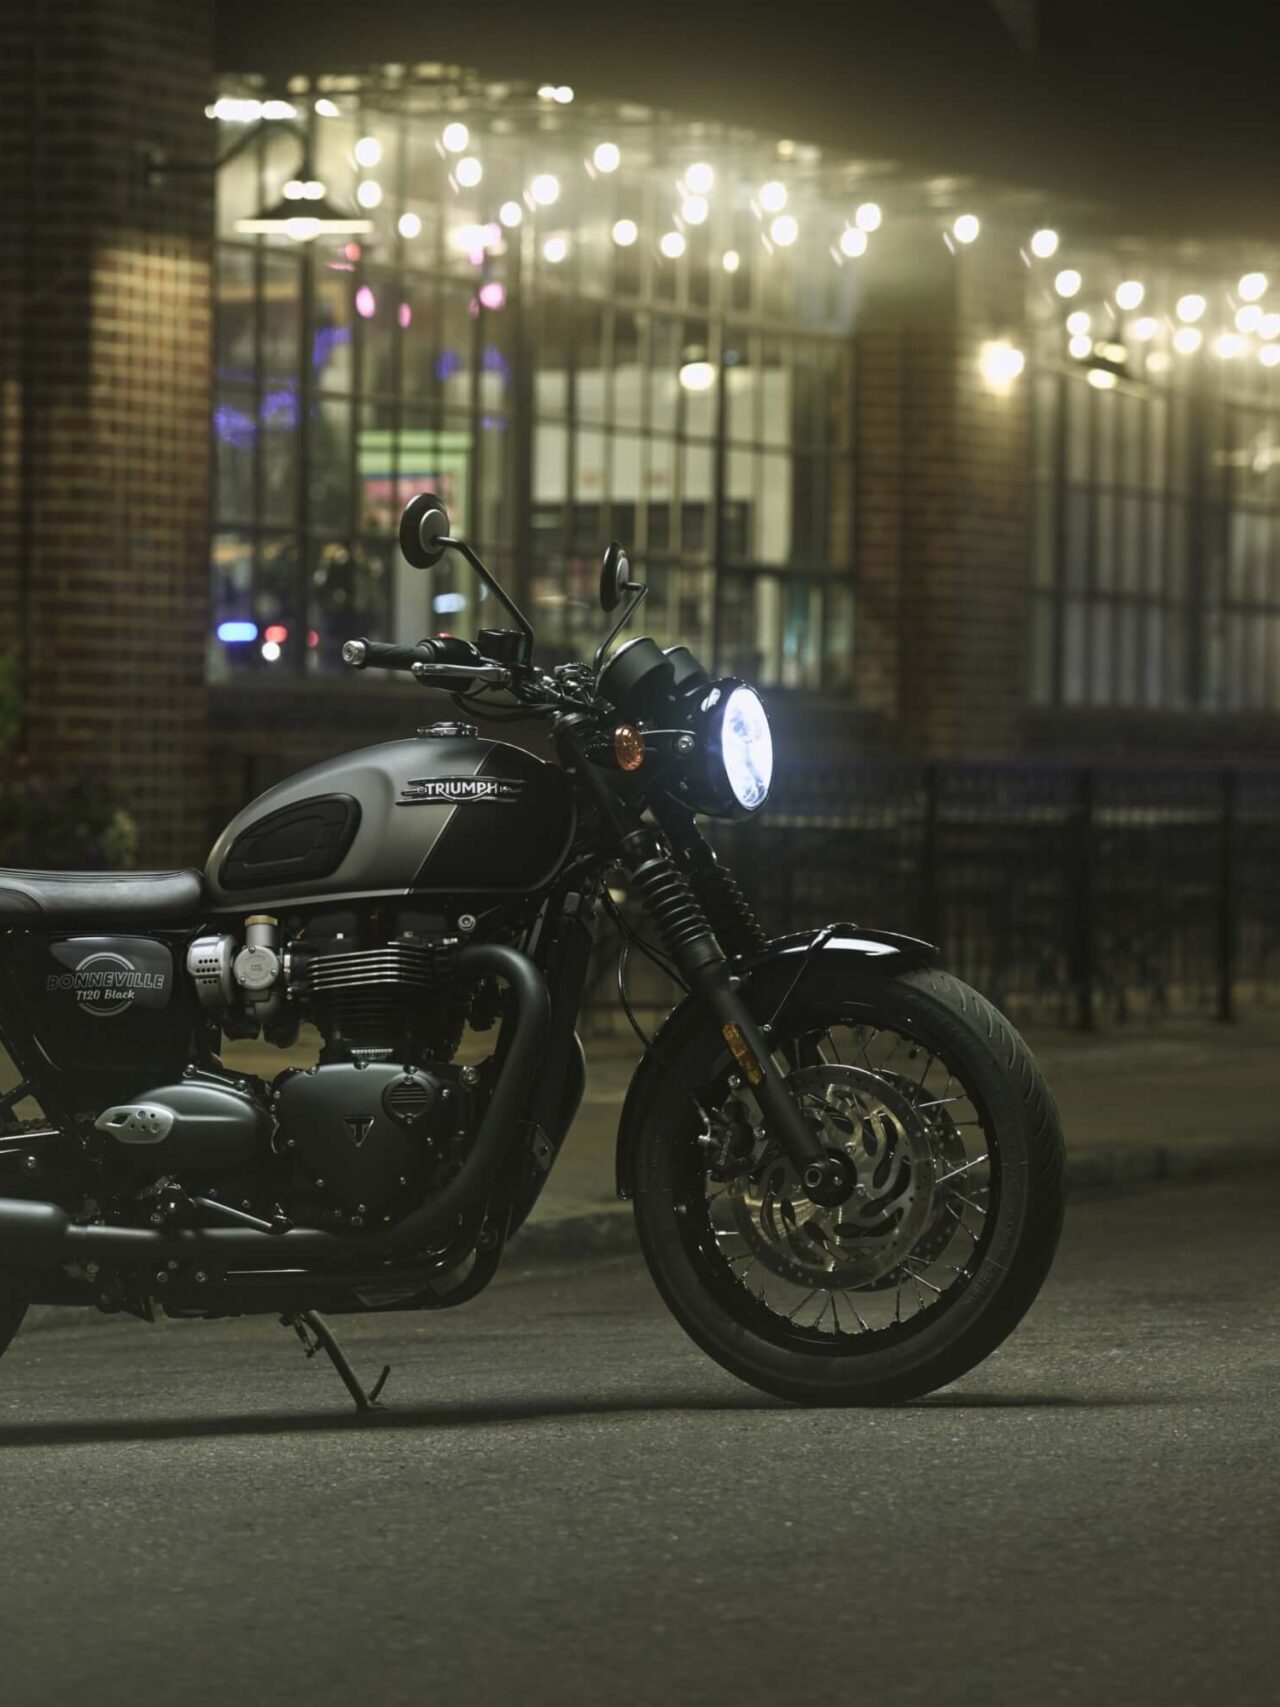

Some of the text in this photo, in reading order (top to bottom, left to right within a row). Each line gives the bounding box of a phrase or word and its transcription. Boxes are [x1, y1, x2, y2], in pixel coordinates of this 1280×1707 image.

[424, 782, 498, 797] TRIUMPH
[46, 971, 165, 991] BONNEVILLE
[75, 989, 136, 1001] T120 Black
